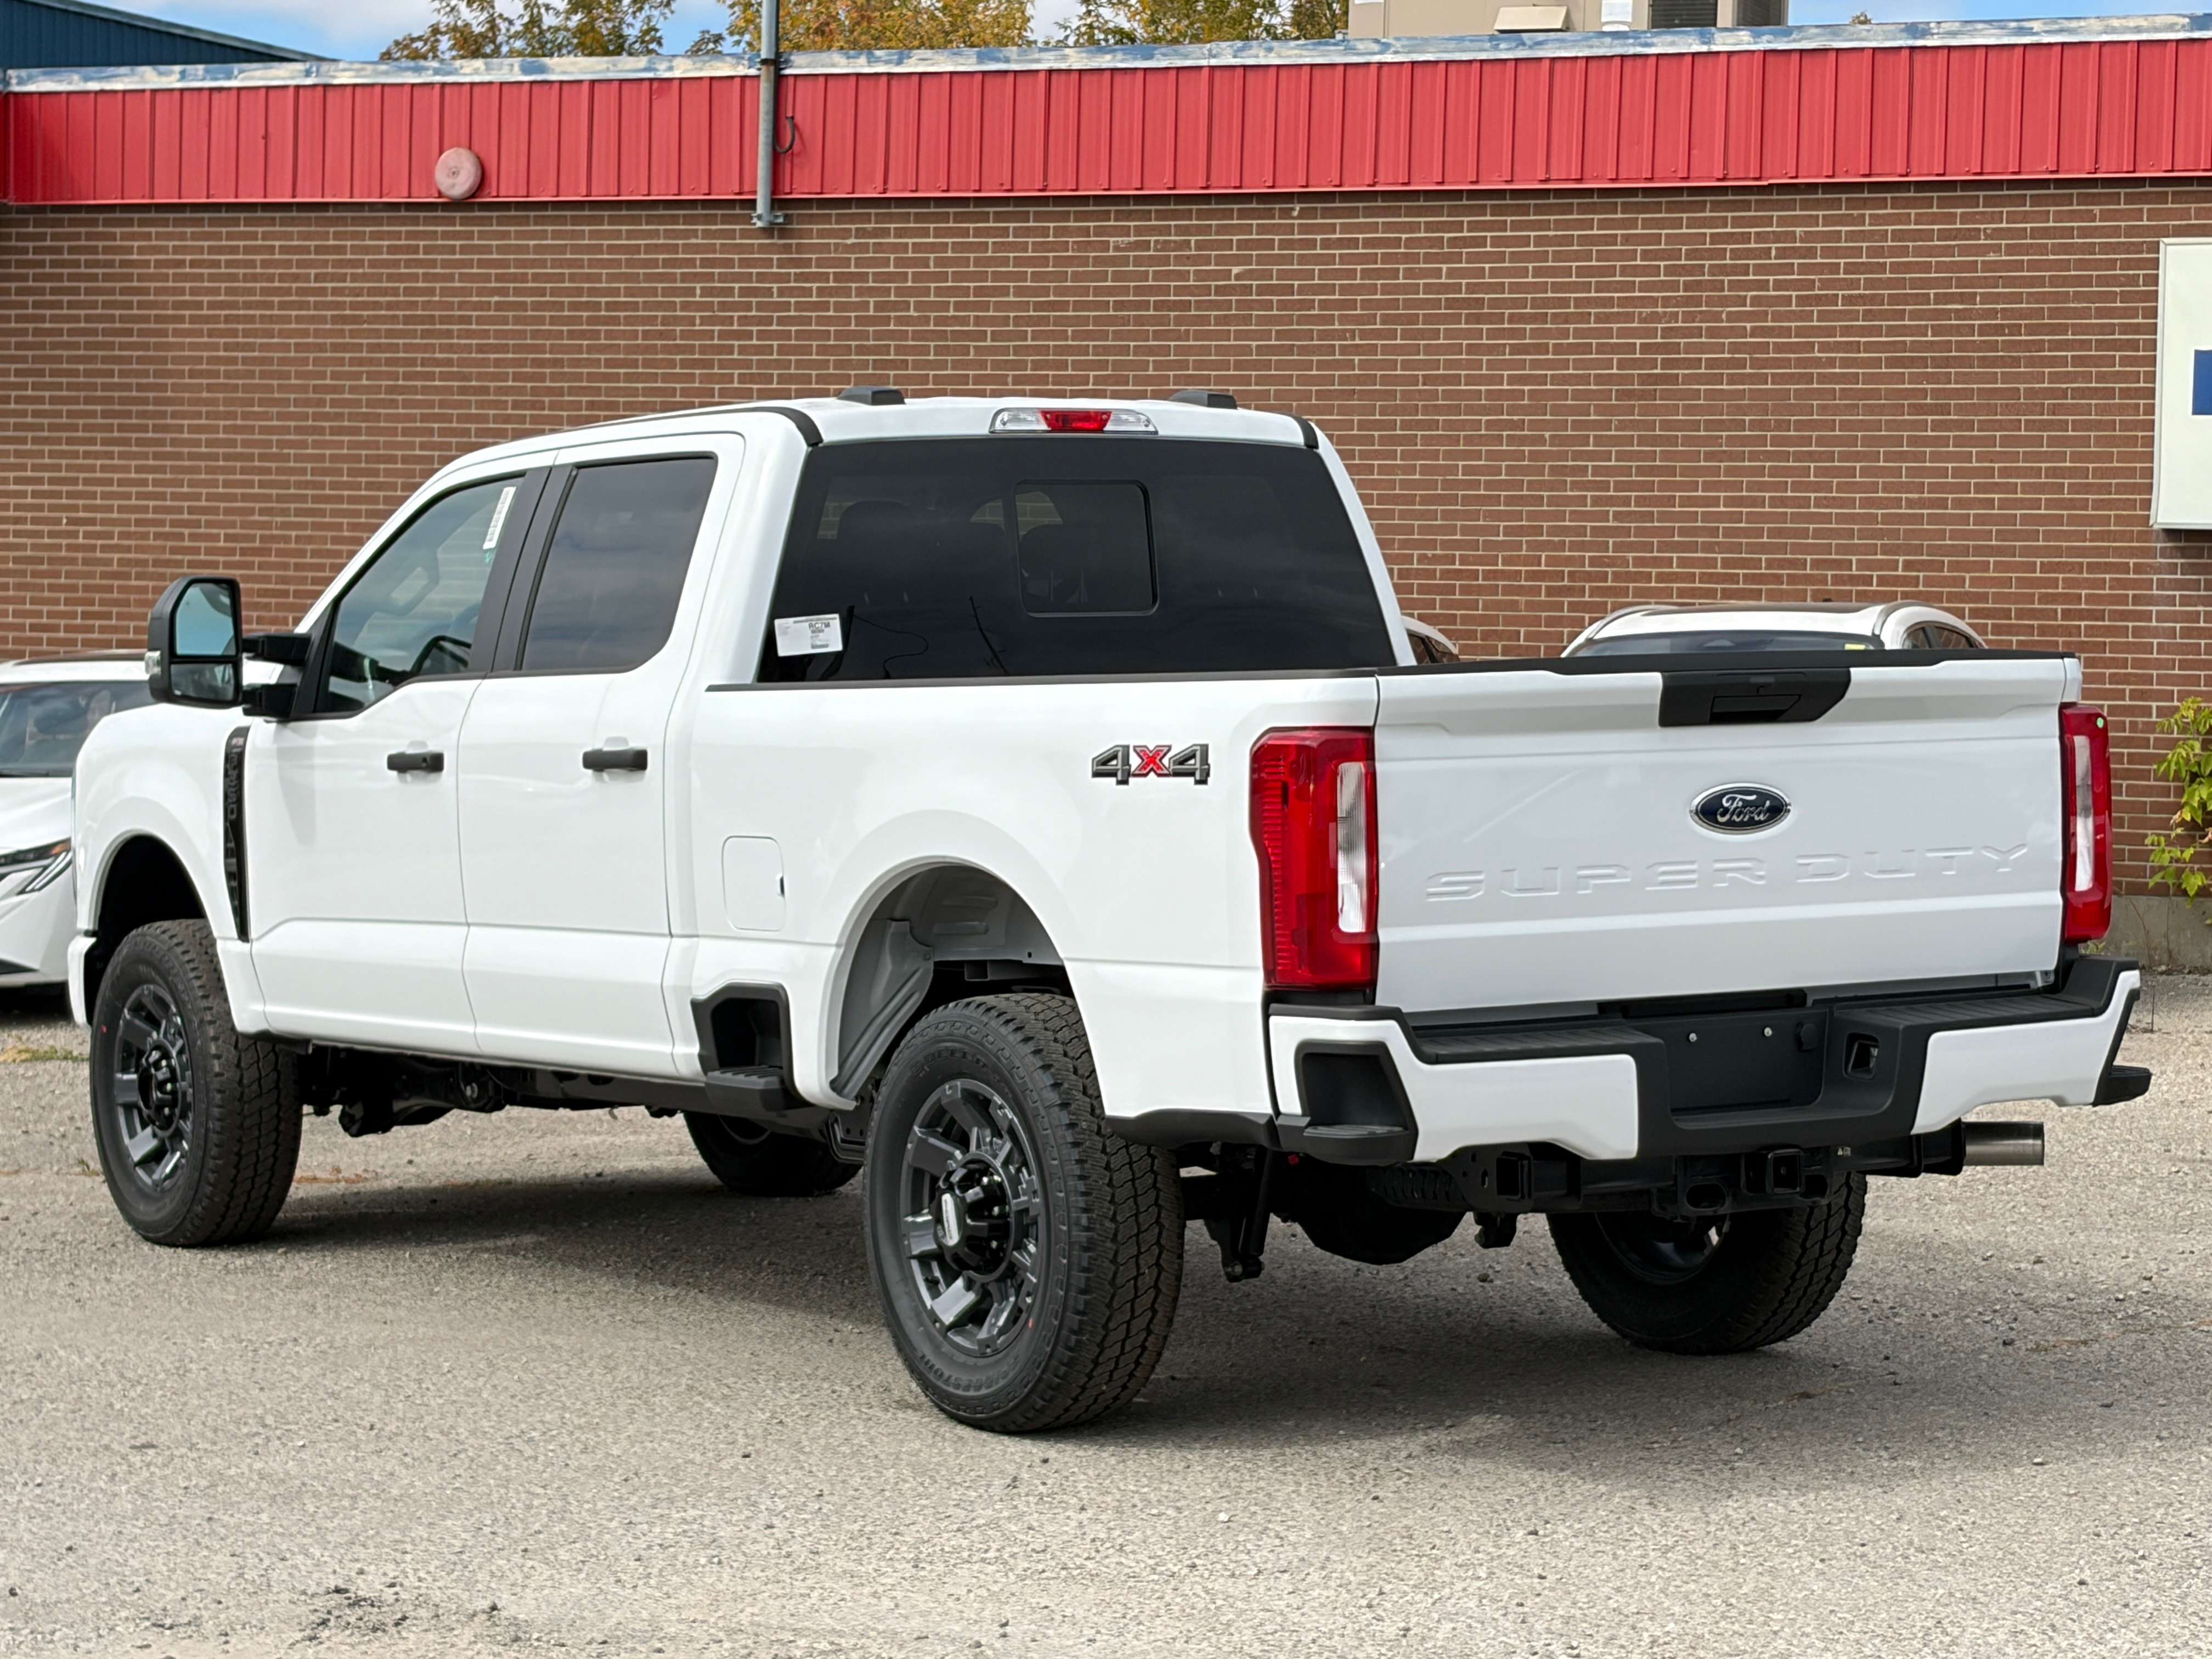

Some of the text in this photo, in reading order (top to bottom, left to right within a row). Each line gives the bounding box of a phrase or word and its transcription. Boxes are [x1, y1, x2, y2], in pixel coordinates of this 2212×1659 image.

[1092, 743, 1210, 786] 4X4
[1717, 794, 1770, 822] Ford
[1426, 843, 2028, 901] SUPER DUTY
